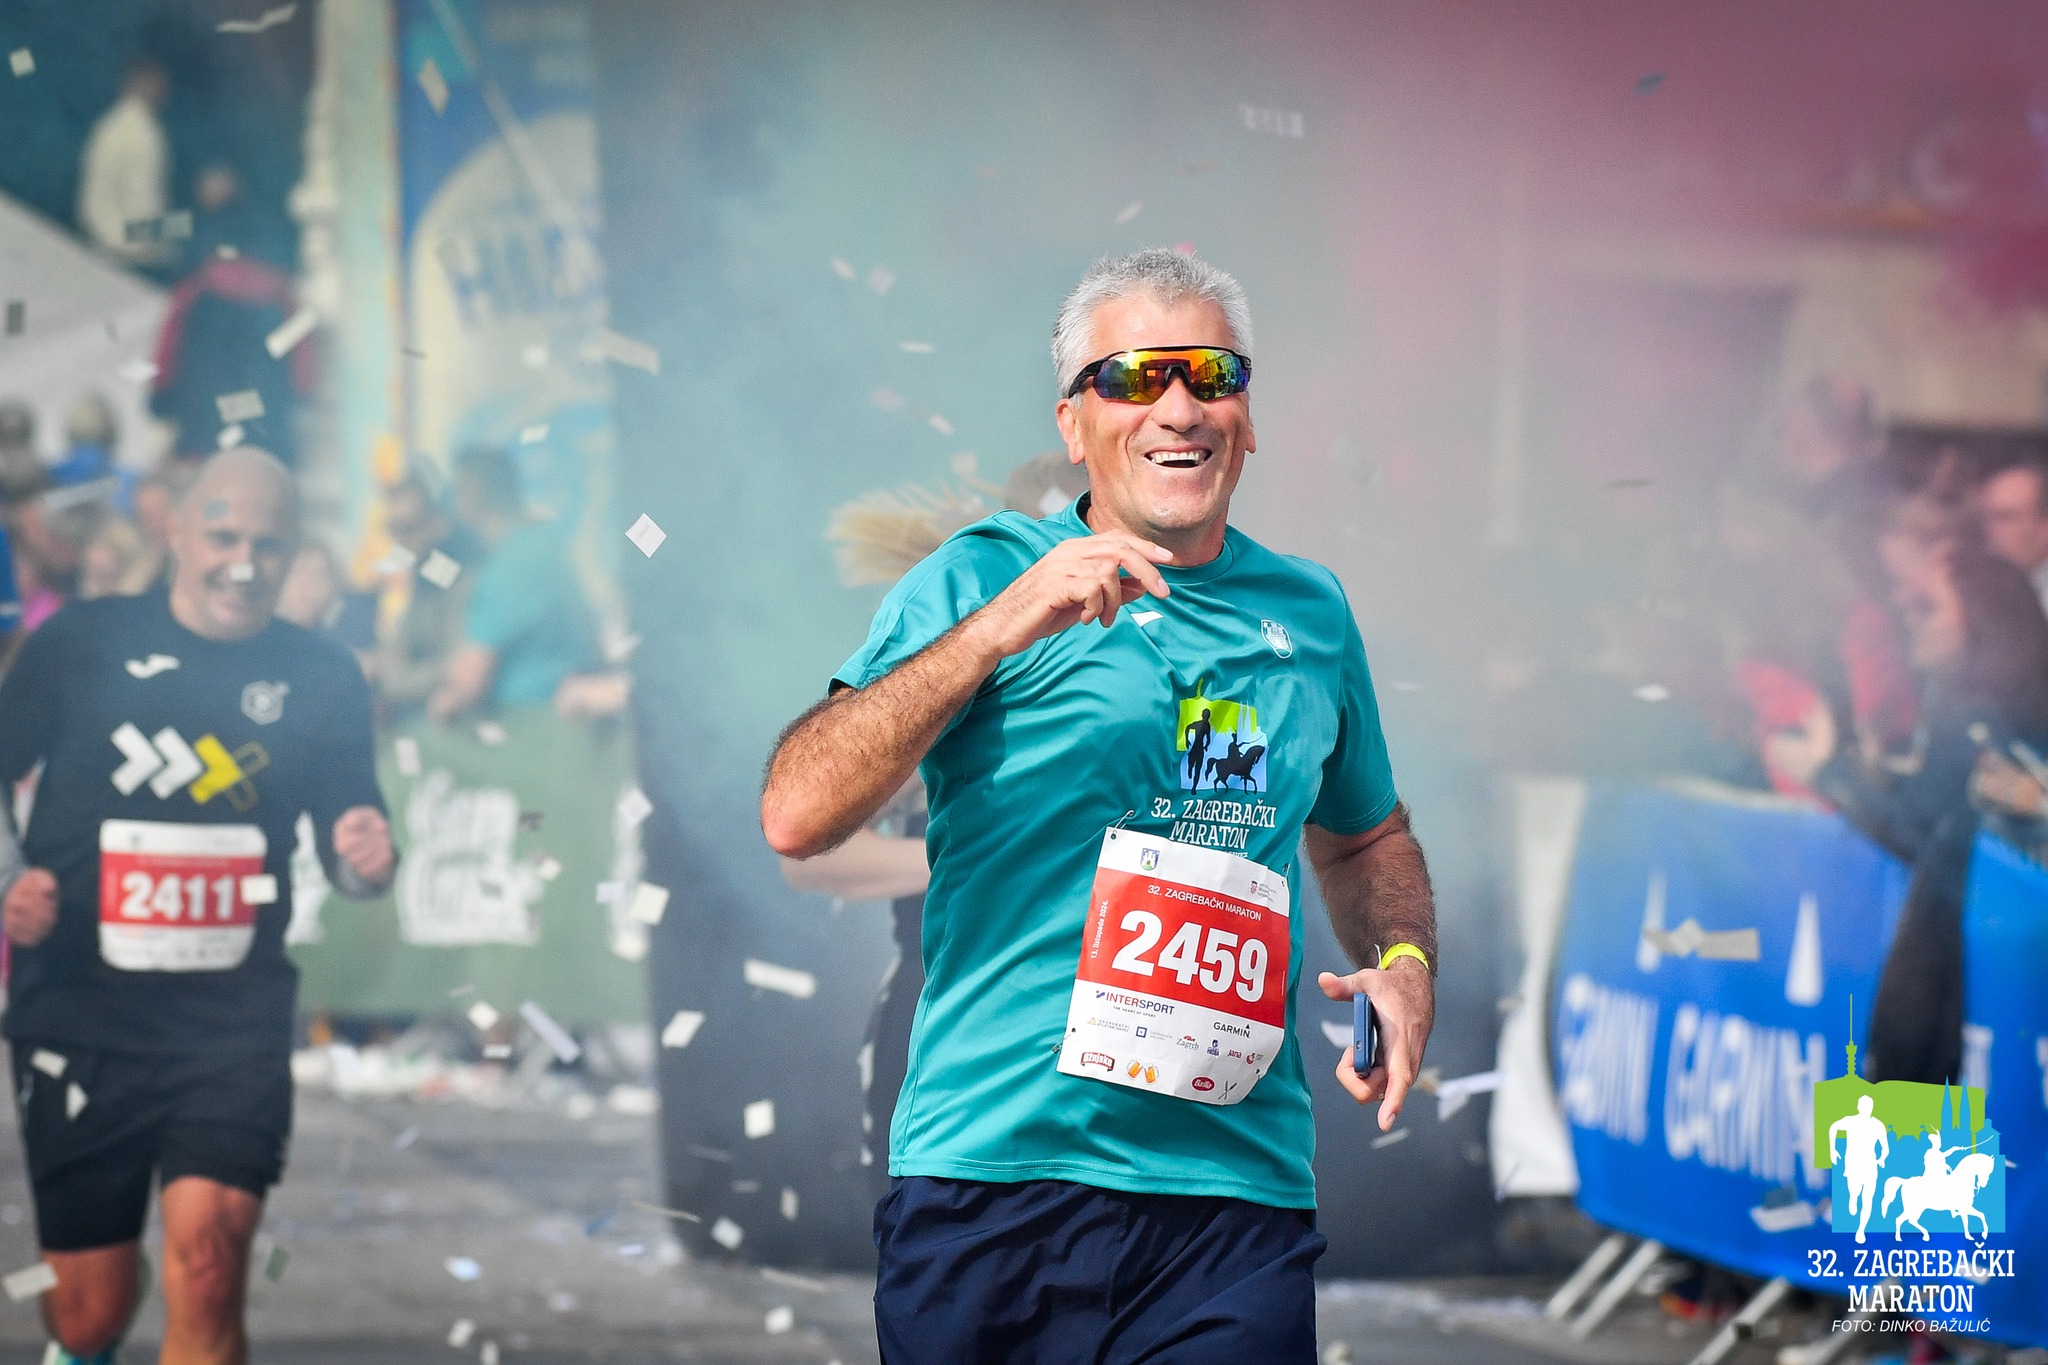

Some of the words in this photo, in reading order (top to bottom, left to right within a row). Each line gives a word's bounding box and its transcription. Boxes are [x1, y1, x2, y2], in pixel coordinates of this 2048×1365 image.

[1151, 797, 1176, 818] 32.
[1182, 799, 1276, 828] ZAGREBAČKI
[1169, 821, 1249, 849] MARATON
[119, 869, 235, 922] 2411
[1147, 884, 1162, 896] 32.
[1165, 888, 1224, 910] ZAGREBAČKI
[1226, 903, 1261, 921] MARATON
[1112, 910, 1268, 1003] 2459
[1106, 992, 1175, 1015] INTERSPORT
[1213, 1021, 1251, 1038] GARMIN
[1176, 1038, 1199, 1051] Zagreb
